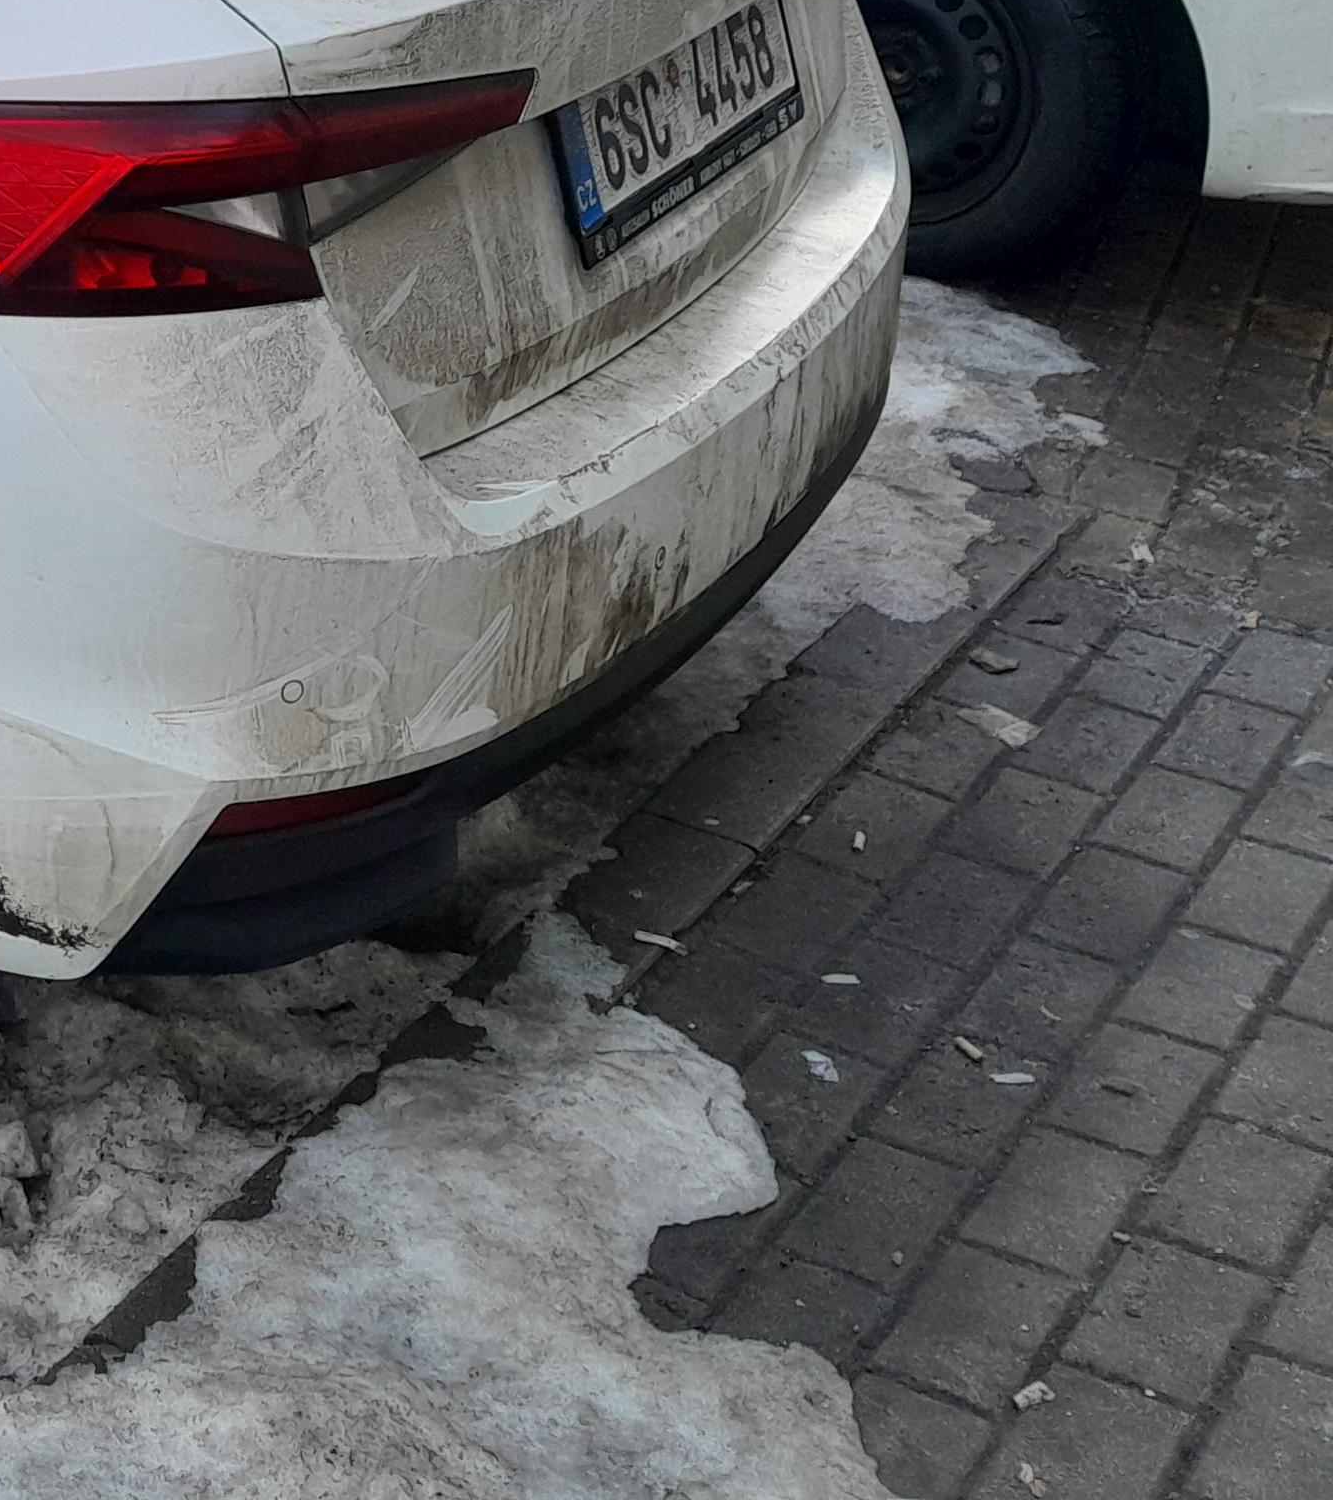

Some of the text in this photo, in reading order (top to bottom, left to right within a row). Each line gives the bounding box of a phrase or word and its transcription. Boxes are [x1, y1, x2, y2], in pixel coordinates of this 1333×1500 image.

[595, 71, 672, 191] 6SC
[689, 4, 775, 127] 4458
[576, 178, 598, 212] CZ
